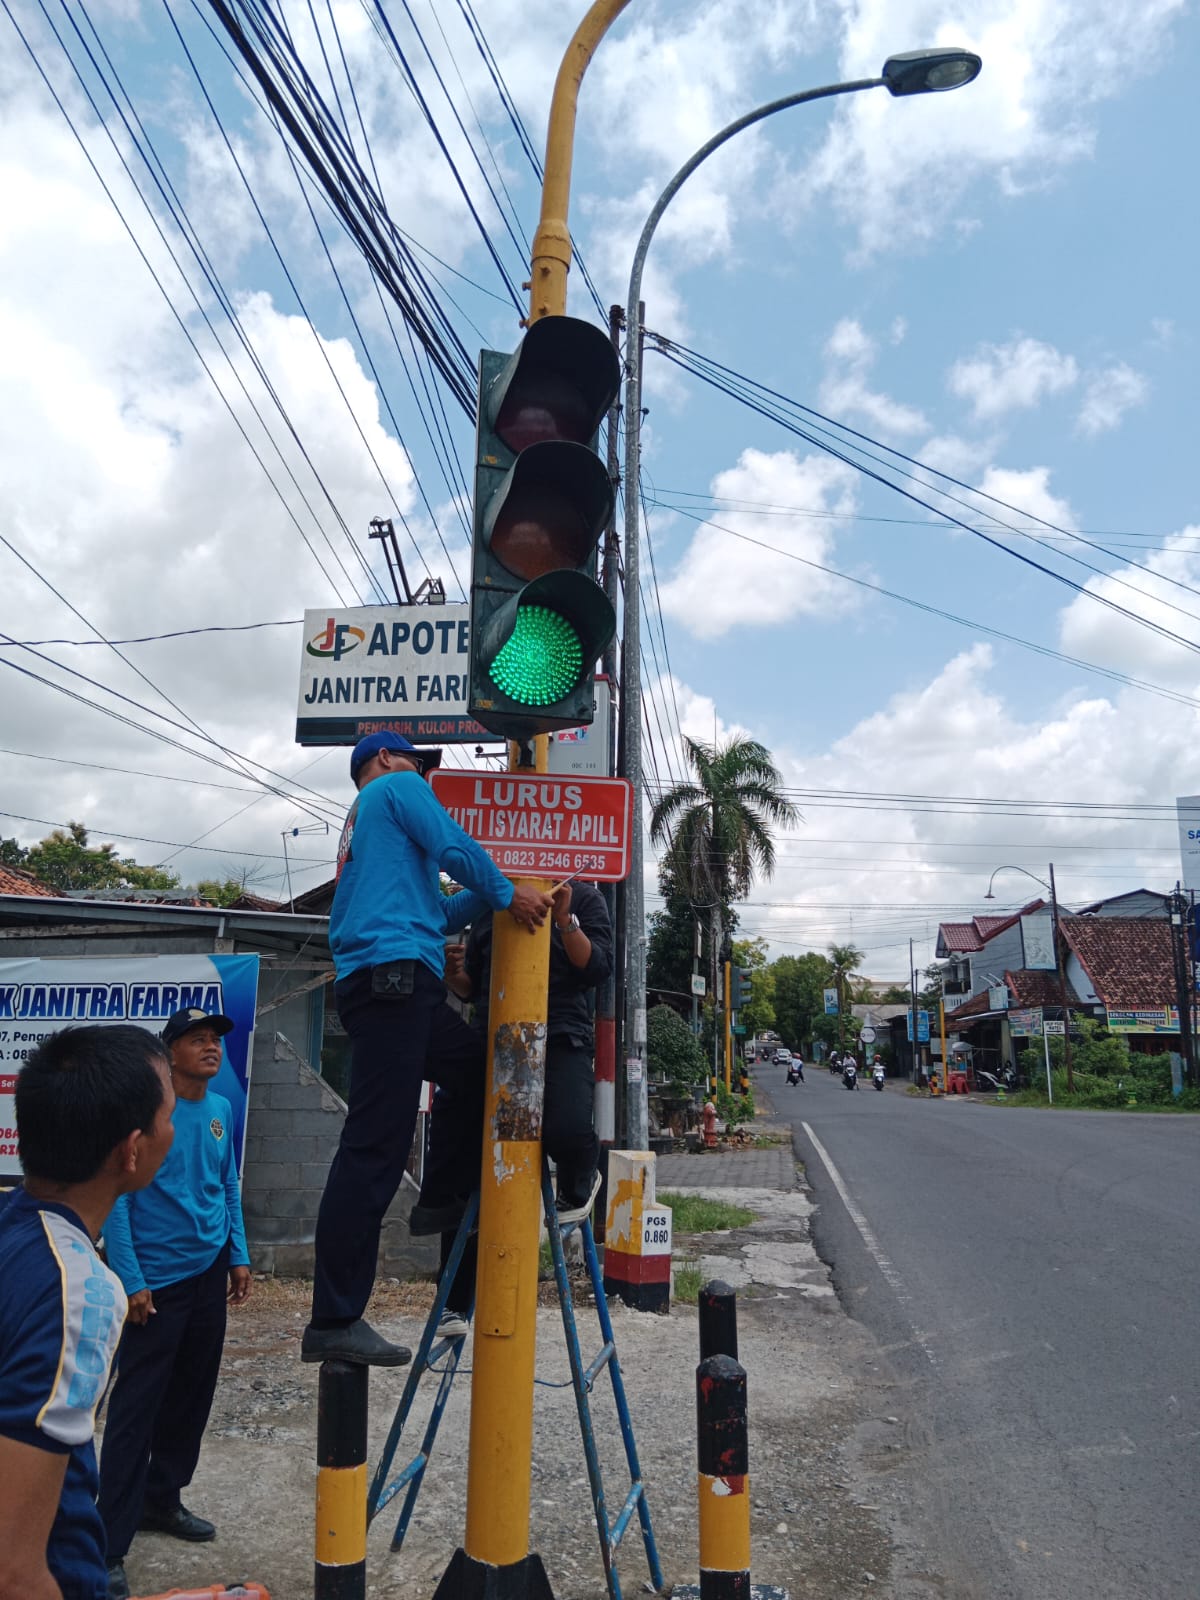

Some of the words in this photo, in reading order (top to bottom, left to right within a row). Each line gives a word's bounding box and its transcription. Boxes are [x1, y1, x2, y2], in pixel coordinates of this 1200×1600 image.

[367, 620, 469, 656] APOTE
[304, 675, 408, 704] JANITRA
[416, 674, 467, 702] FAR
[417, 720, 455, 734] KULON
[474, 779, 583, 810] LURUS
[488, 808, 564, 841] ISYARAT
[568, 813, 619, 844] APILL
[503, 850, 535, 866] 0823
[539, 852, 570, 868] 2546
[574, 854, 606, 870] 6535
[19, 985, 125, 1018] JANITRA
[129, 985, 221, 1018] FARMA
[646, 1216, 667, 1226] PGS
[644, 1230, 669, 1243] 0.860
